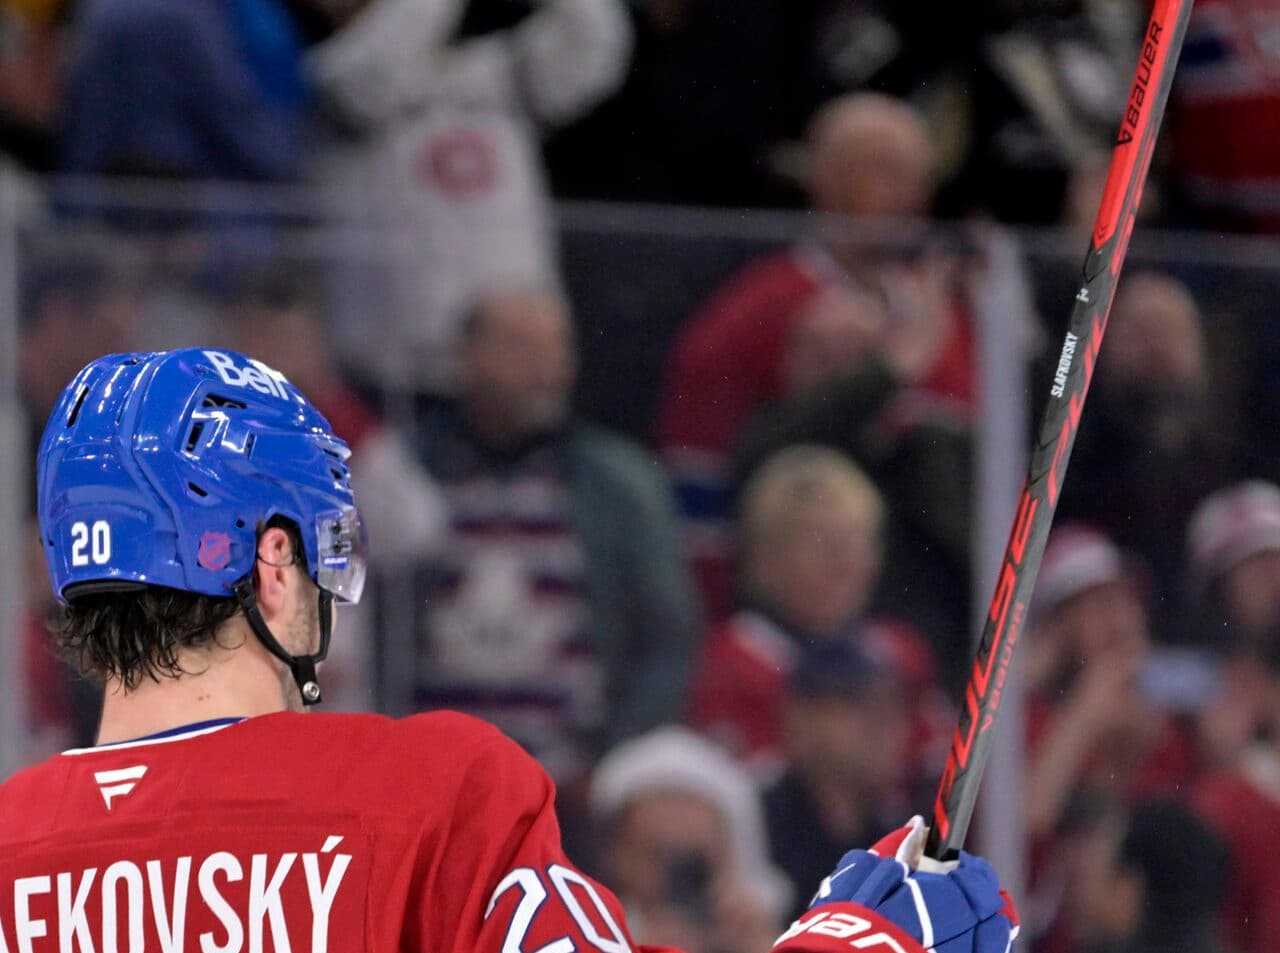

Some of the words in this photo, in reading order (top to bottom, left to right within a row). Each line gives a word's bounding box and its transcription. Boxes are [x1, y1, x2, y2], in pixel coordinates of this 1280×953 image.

[1126, 20, 1163, 129] BAUER
[1050, 331, 1078, 398] SLAFKOVSKY
[71, 520, 111, 566] 20
[934, 472, 1038, 841] PULSE
